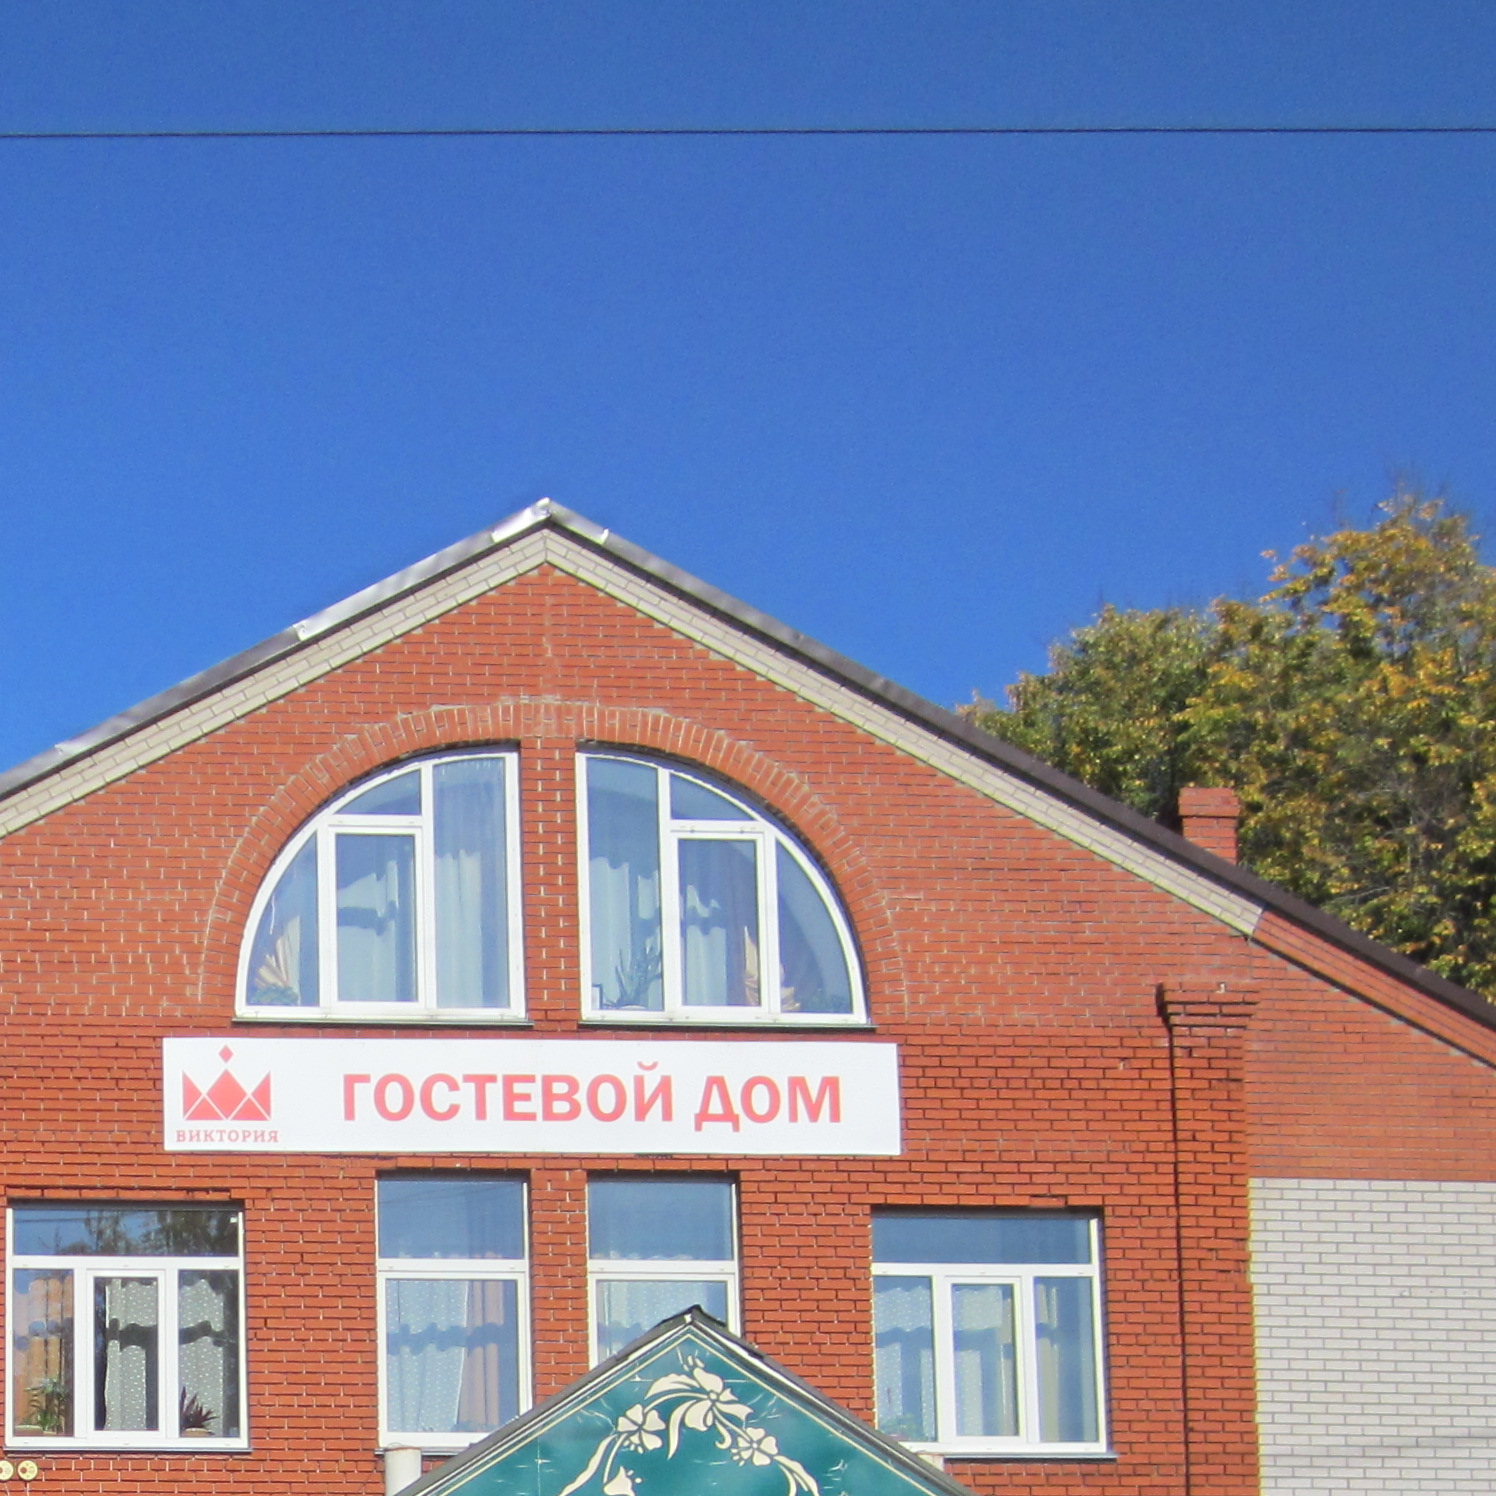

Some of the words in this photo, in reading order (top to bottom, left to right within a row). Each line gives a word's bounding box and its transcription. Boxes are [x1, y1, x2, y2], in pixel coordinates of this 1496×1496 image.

[341, 1061, 673, 1123] ГОСТЕВОЙ
[694, 1074, 842, 1133] ДОМ
[175, 1129, 280, 1144] ВИКТОРИЯ
